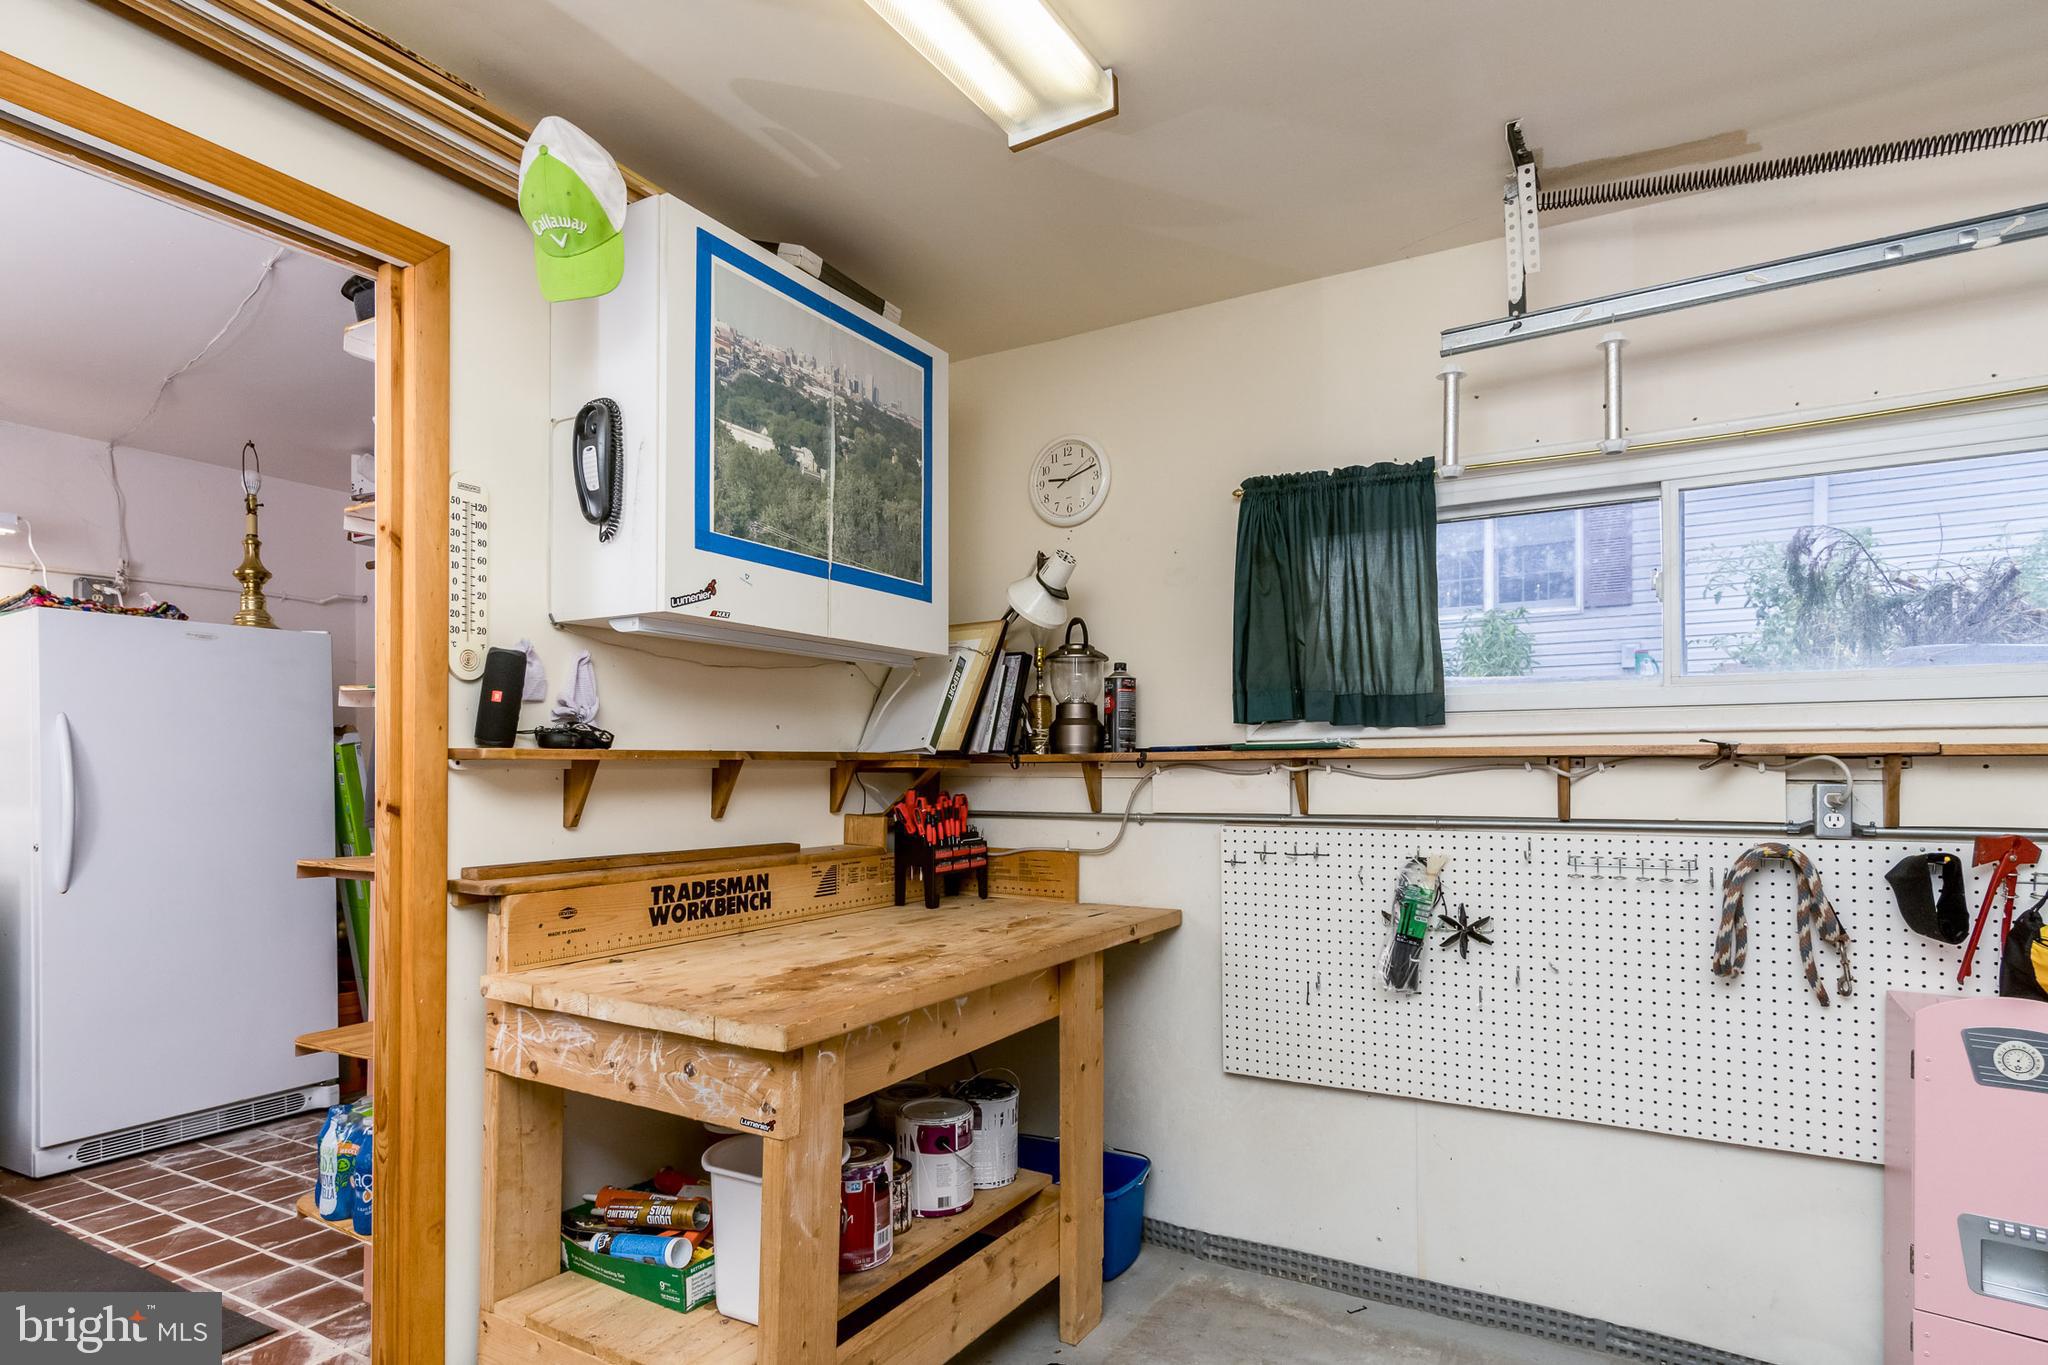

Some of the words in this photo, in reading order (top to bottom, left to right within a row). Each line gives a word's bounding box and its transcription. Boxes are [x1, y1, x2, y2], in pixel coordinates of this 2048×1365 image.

[532, 213, 588, 236] Callaway
[1063, 446, 1072, 457] 12
[1080, 448, 1084, 458] 1
[1051, 453, 1058, 464] 11
[1042, 466, 1050, 476] 10
[1093, 470, 1099, 480] 3
[1038, 480, 1045, 490] 9
[450, 495, 461, 505] 50
[1043, 493, 1050, 503] 8
[474, 503, 487, 512] 120
[1054, 502, 1060, 512] 7
[1066, 503, 1073, 513] 6
[450, 512, 461, 521] 40
[474, 521, 487, 530] 100
[450, 528, 461, 537] 30
[450, 544, 461, 553] 20
[477, 539, 487, 548] 80
[451, 561, 459, 569] 10
[477, 556, 487, 565] 60
[452, 577, 458, 585] 0
[477, 575, 487, 583] 40
[476, 591, 487, 600] 20
[671, 590, 711, 607] Lumenier
[450, 609, 460, 618] 20
[479, 609, 485, 617] 0
[450, 626, 460, 634] 30
[476, 627, 487, 635] 20
[947, 670, 961, 701] REPORT
[650, 873, 769, 905] TRADESMAN
[648, 891, 772, 927] WORKBENCH
[567, 927, 586, 935] CANADA
[606, 1209, 639, 1219] PANELING
[649, 1205, 674, 1215] NAILS
[646, 1214, 672, 1225] LIQUID
[660, 1280, 665, 1290] 9
